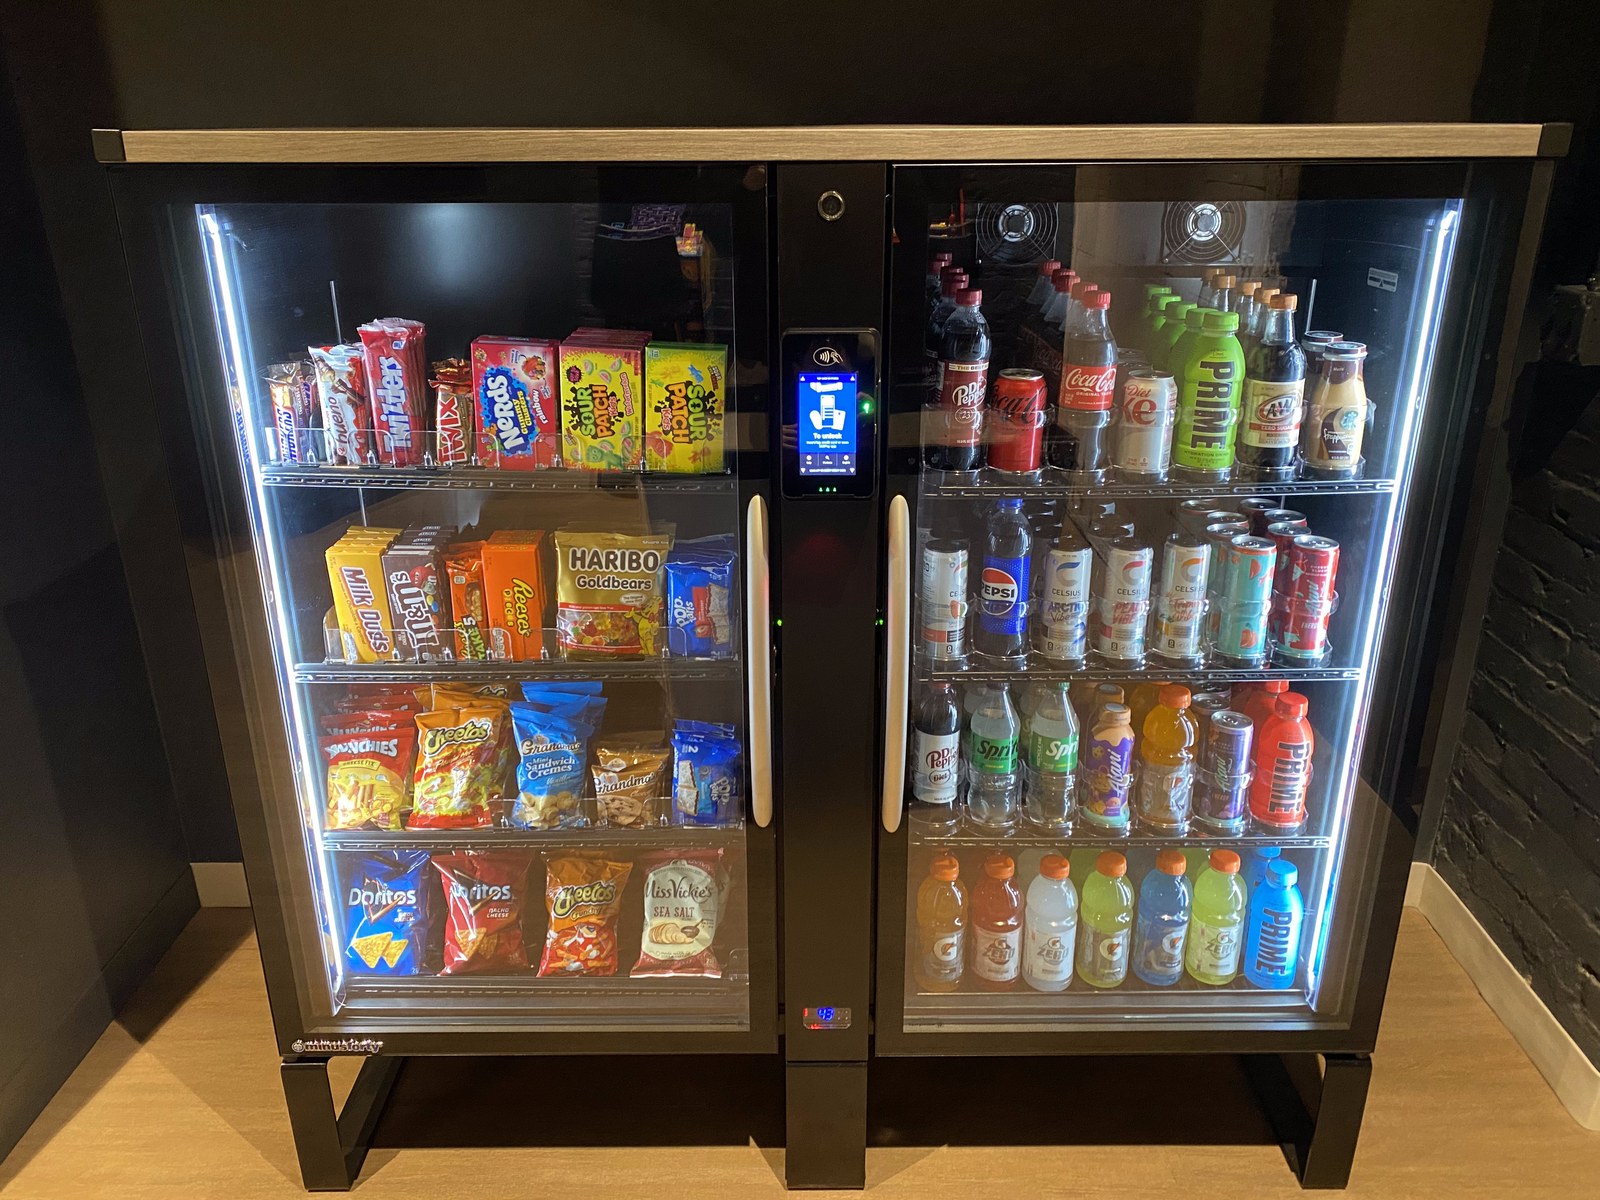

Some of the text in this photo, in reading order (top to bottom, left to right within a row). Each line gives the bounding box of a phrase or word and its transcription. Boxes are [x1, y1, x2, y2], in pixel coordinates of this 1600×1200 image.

[1127, 384, 1152, 398] Diet
[1190, 360, 1235, 449] PRIME
[531, 389, 549, 425] rainbow
[577, 387, 596, 436] SOUR
[591, 384, 613, 438] PATCH
[607, 396, 619, 417] Kids
[661, 407, 672, 430] Kids
[667, 382, 690, 443] PATCH
[687, 384, 706, 440] SOUR
[569, 547, 661, 573] HARIBO
[342, 566, 375, 606] Milk
[575, 574, 653, 591] Goldbears
[980, 581, 1015, 599] PEPSI
[1051, 588, 1081, 597] CELSIUS
[462, 616, 476, 626] 5
[511, 577, 536, 638] Reese's
[358, 609, 390, 653] Duds
[424, 719, 492, 755] Cheetos
[525, 757, 576, 771] Sandwich
[527, 764, 573, 781] Cremes
[532, 757, 549, 765] Mini
[1106, 748, 1125, 798] Alani
[1267, 741, 1310, 814] PRIME
[348, 886, 417, 906] Doritos
[553, 881, 617, 918] Cheetos
[669, 876, 713, 904] Vickie's
[653, 906, 695, 918] SEA SALT
[1255, 908, 1292, 976] PRIME
